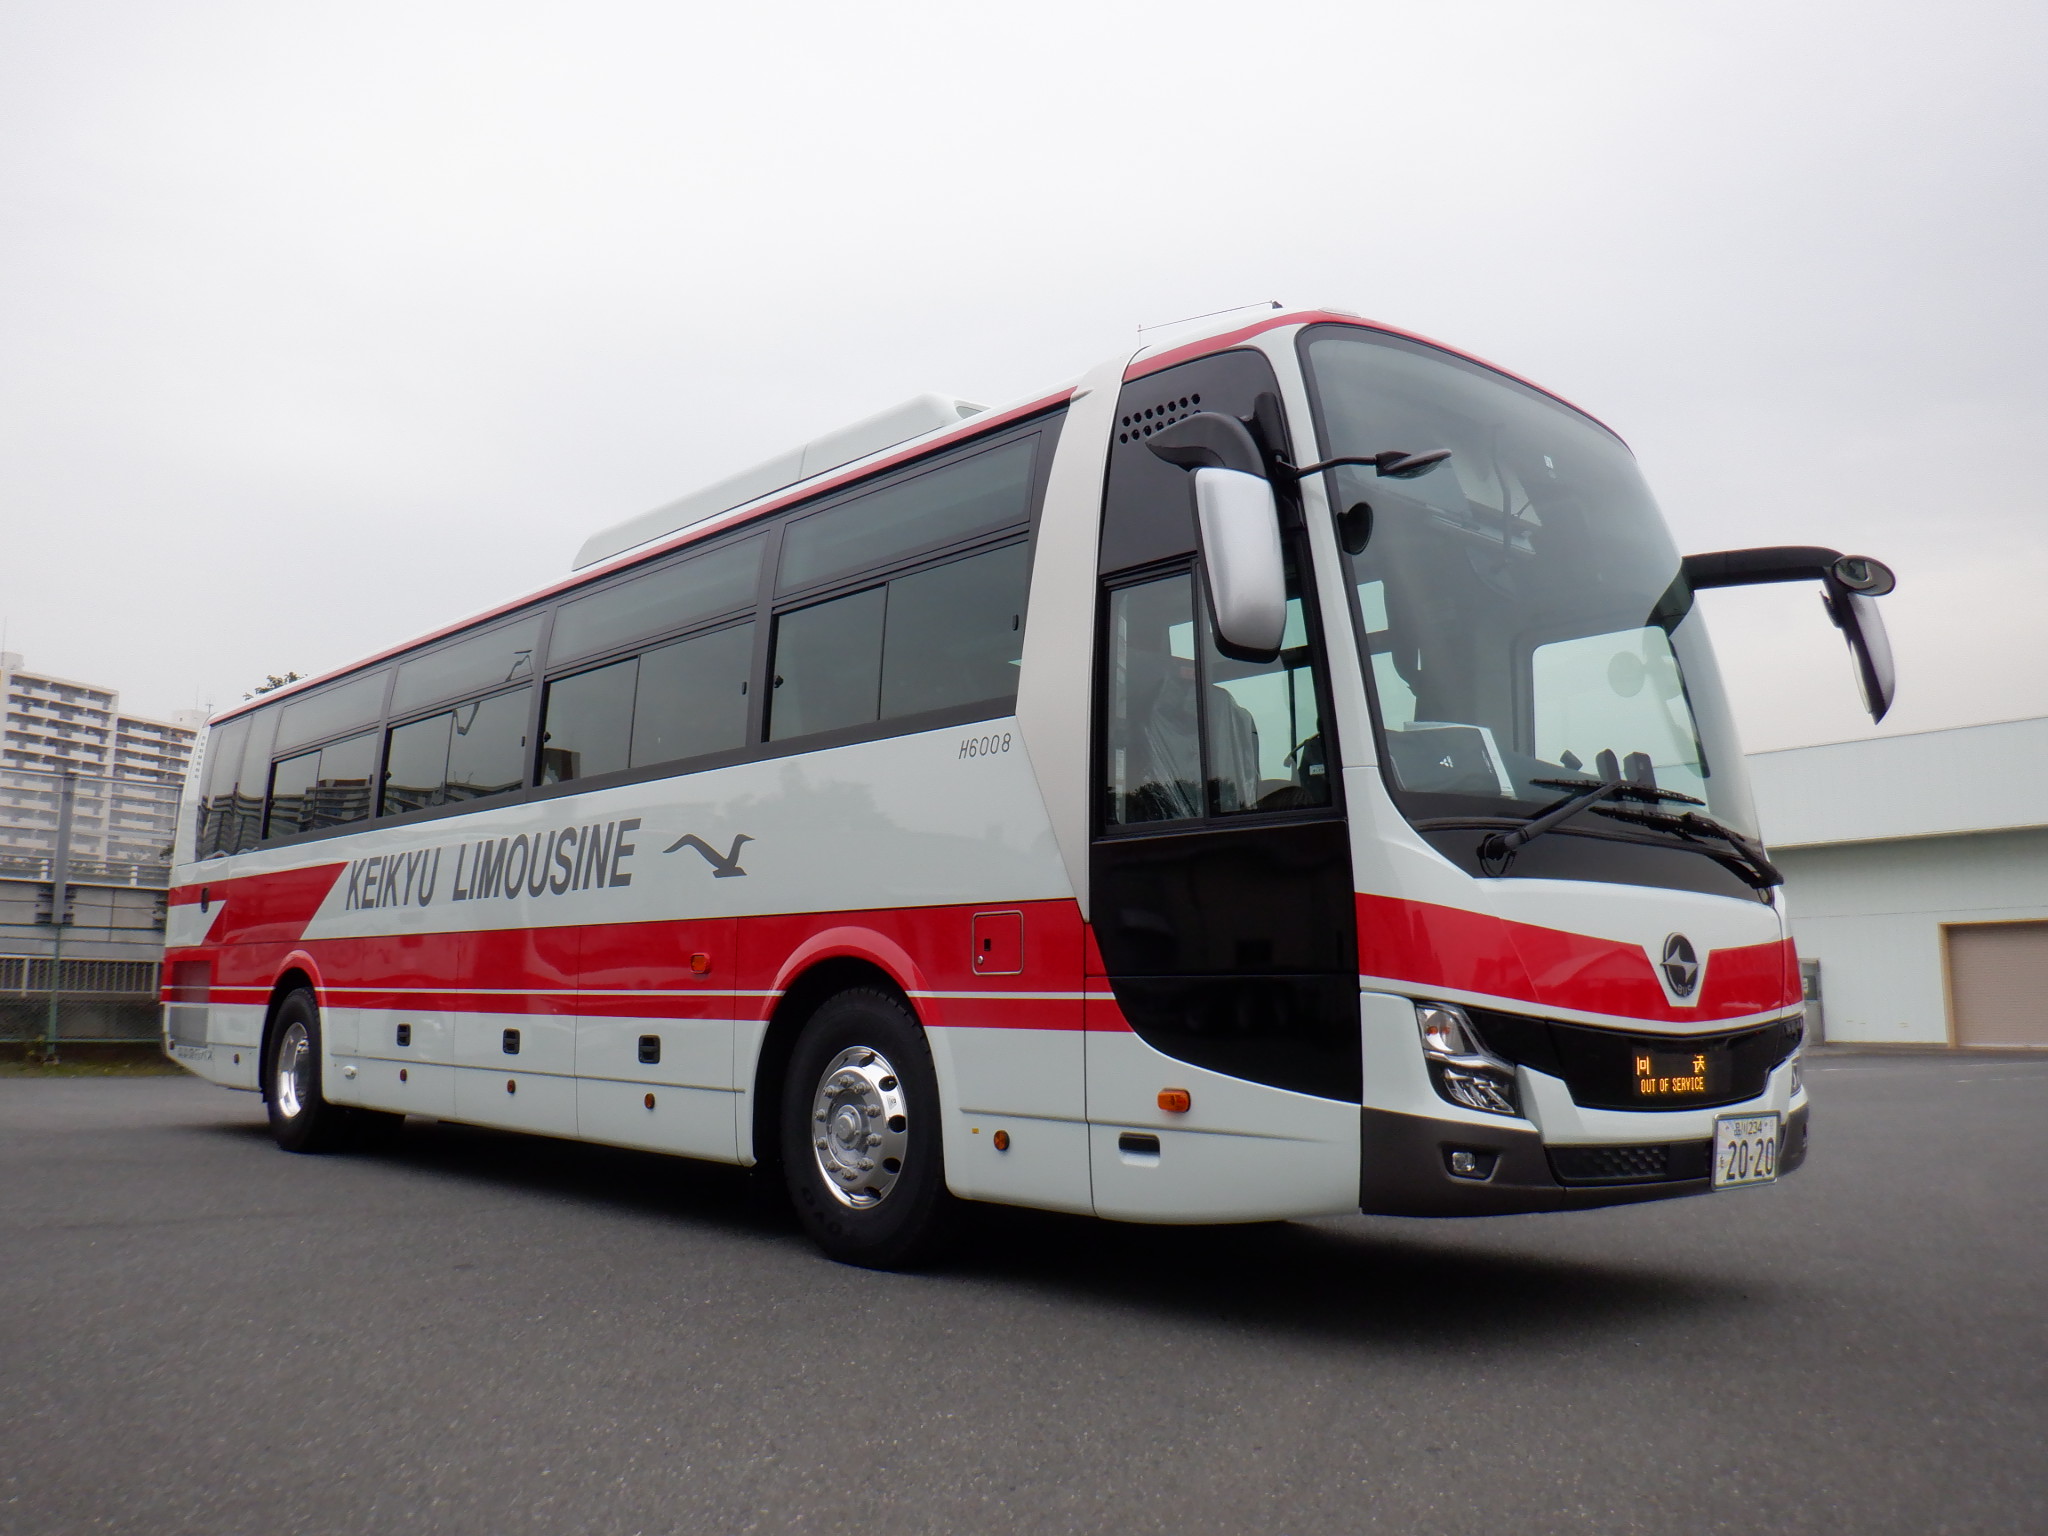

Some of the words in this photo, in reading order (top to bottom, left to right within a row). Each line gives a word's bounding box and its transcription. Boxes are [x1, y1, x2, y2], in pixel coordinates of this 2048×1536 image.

[958, 732, 1012, 760] H6008
[346, 846, 442, 911] KEIKYU
[452, 818, 642, 902] LIMOUSINE
[1677, 983, 1694, 996] BUS
[1640, 1078, 1656, 1093] OUT
[1659, 1077, 1670, 1092] OF
[1672, 1076, 1704, 1092] SERVICE
